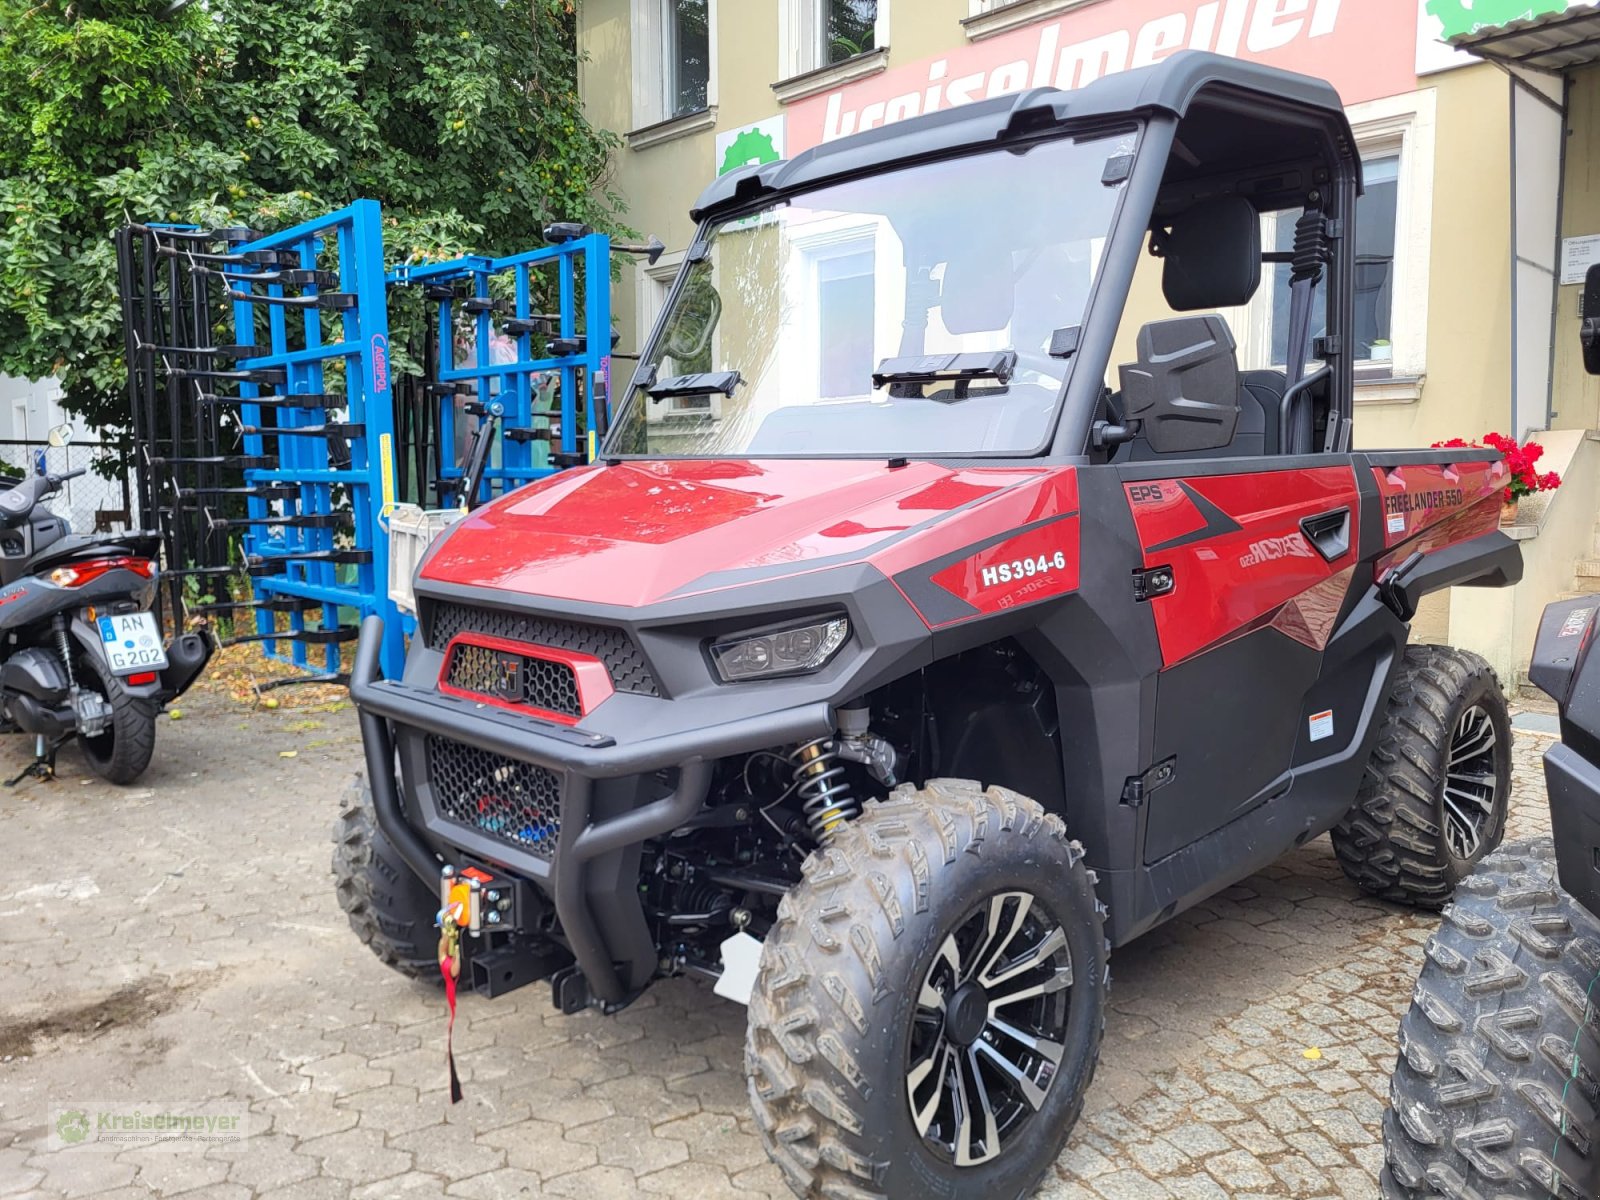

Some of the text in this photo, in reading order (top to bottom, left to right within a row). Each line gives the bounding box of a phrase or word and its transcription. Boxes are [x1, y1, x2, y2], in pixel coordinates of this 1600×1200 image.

[1129, 485, 1163, 501] EPS
[1385, 488, 1463, 514] FREELANDER 550
[981, 551, 1066, 587] HS394-6
[121, 616, 144, 632] AN
